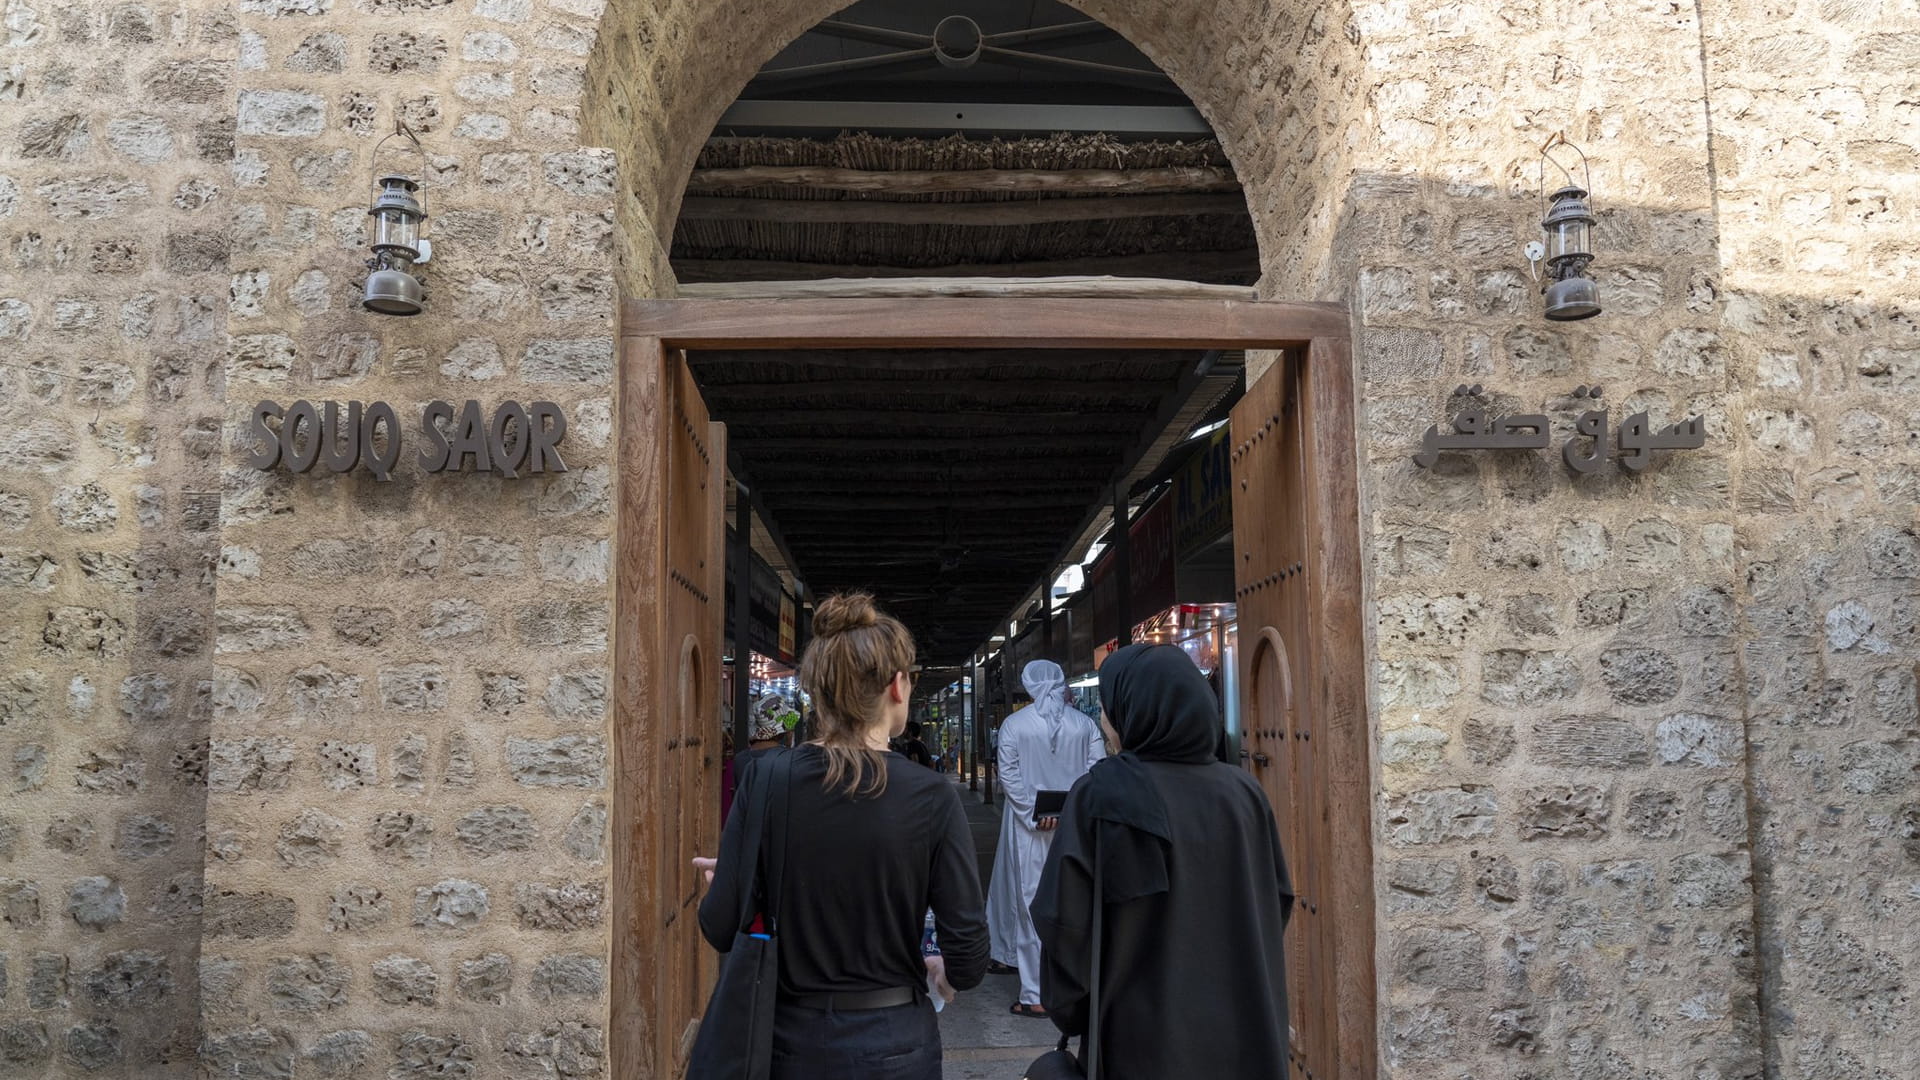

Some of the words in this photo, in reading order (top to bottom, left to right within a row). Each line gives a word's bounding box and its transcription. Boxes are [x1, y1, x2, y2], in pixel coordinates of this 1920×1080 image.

[250, 399, 400, 481] SOUQ
[417, 400, 568, 478] SAQR
[1412, 384, 1550, 468] صقر
[1562, 384, 1705, 473] سوق
